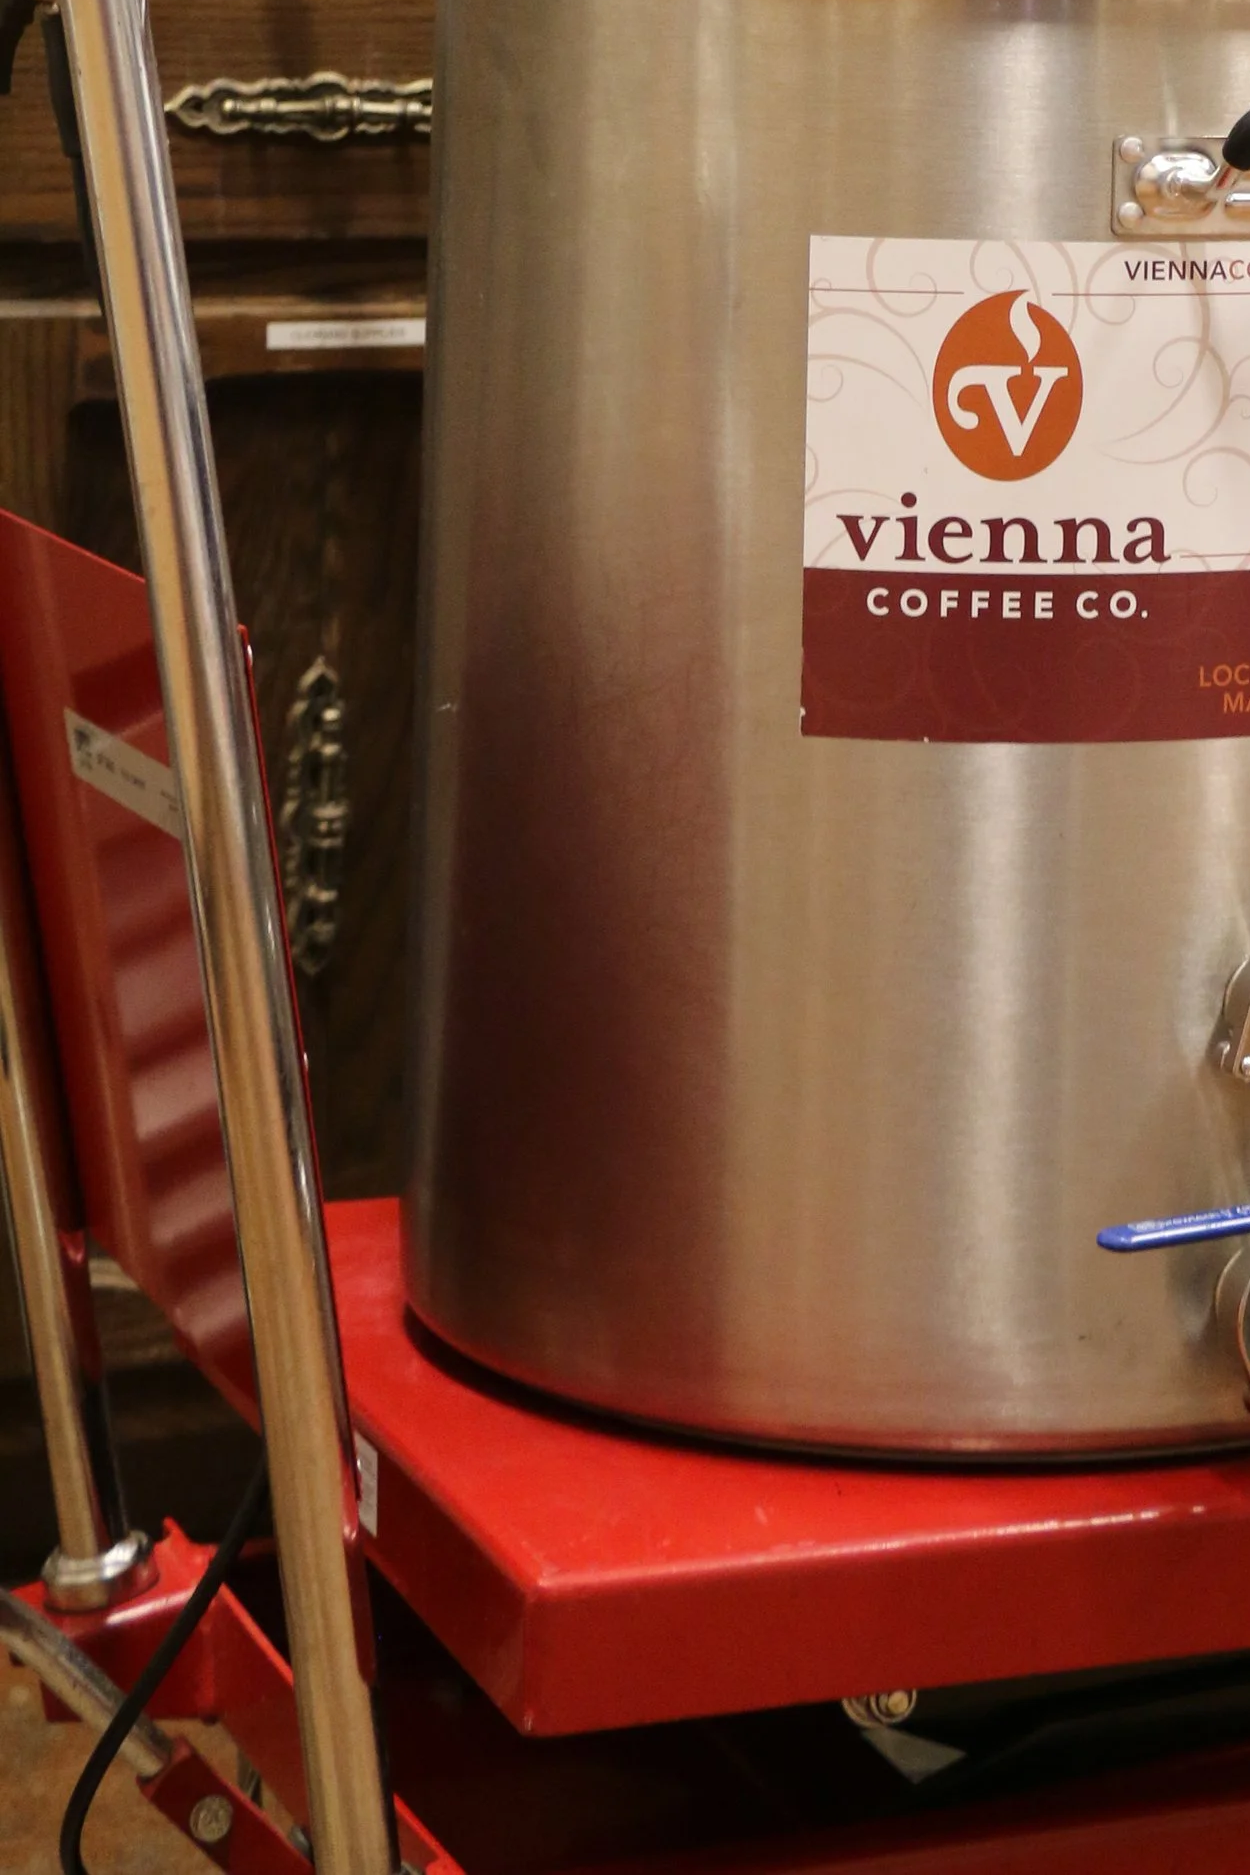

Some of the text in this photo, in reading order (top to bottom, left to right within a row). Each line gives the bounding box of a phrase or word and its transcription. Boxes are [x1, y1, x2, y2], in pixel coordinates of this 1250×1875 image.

[835, 491, 1173, 565] vienna
[865, 587, 1150, 619] COFFEE CO.
